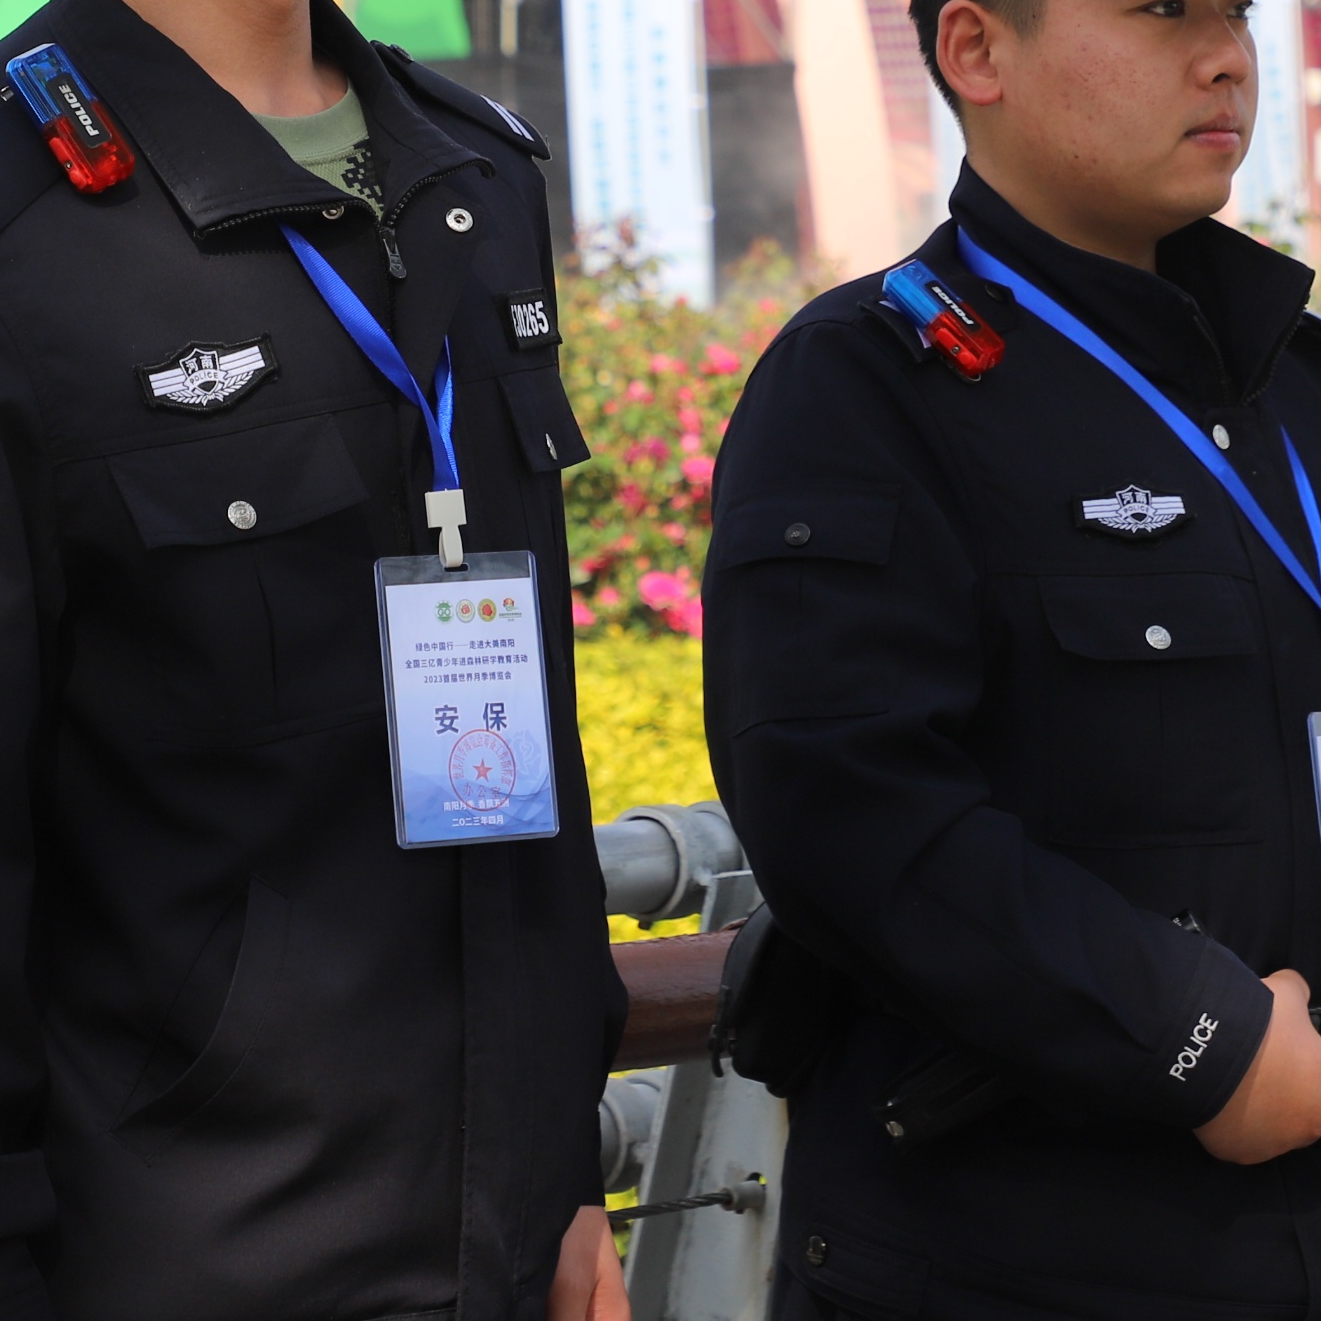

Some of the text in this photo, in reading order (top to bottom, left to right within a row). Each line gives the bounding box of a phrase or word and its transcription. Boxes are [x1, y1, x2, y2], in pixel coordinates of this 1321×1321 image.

[58, 82, 100, 137] POLICE
[931, 286, 975, 325] POLICE
[184, 355, 215, 375] 河南
[189, 371, 219, 384] POLICE
[1123, 505, 1150, 514] POLICE
[424, 671, 512, 684] 2023首届世界月季博览会
[1168, 1012, 1220, 1082] POLICE
